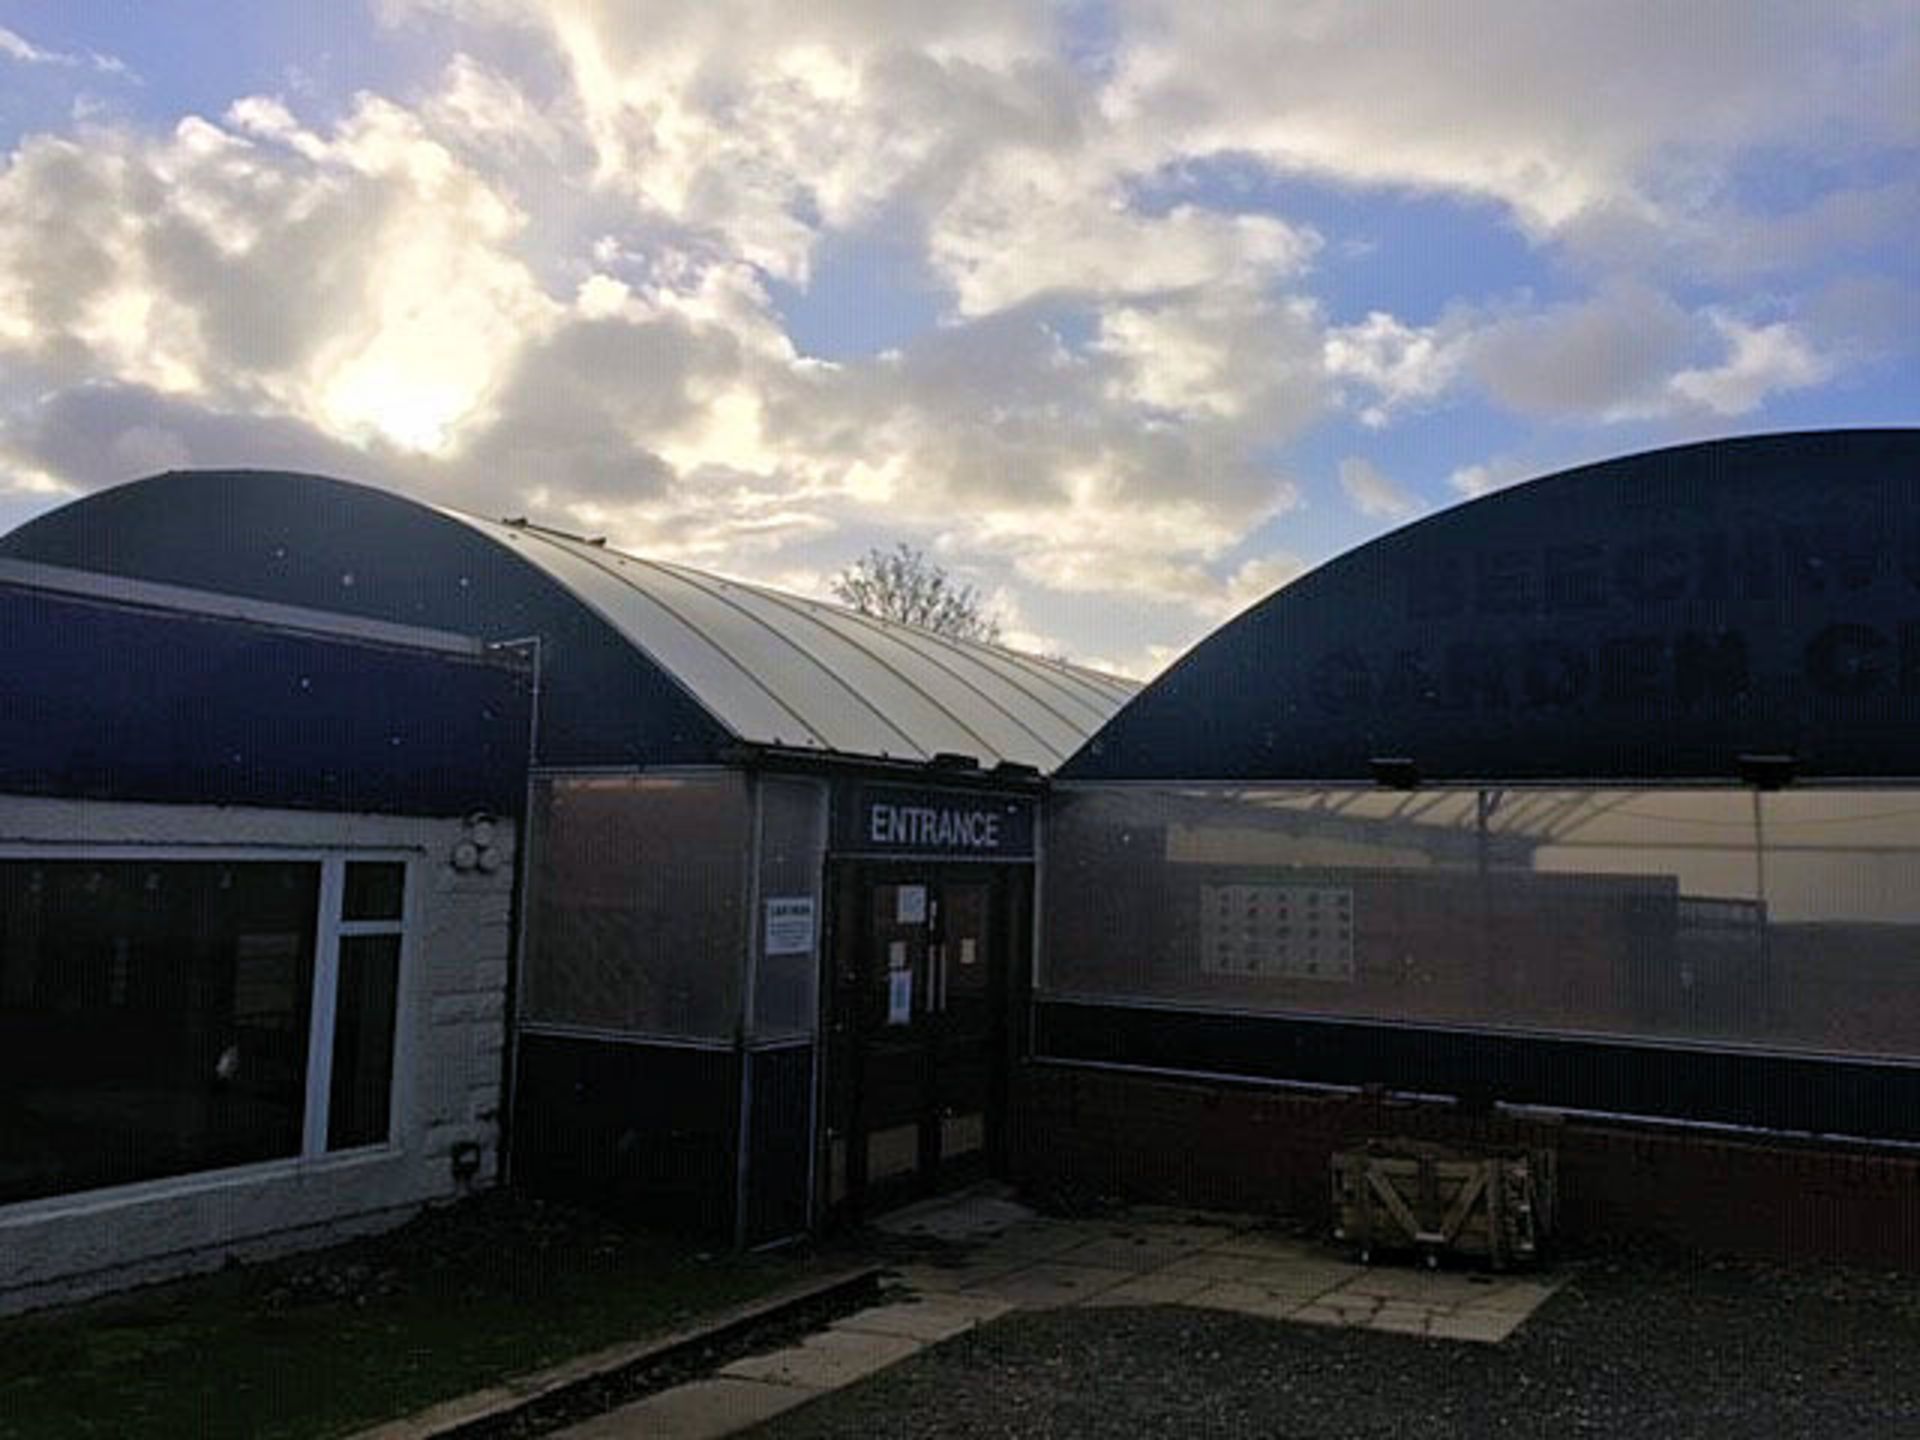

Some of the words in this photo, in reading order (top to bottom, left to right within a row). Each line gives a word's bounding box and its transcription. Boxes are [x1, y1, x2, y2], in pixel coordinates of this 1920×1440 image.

[1406, 524, 1920, 620] BEECHW
[1308, 627, 1750, 715] GARDEN
[871, 804, 999, 847] ENTRANCE
